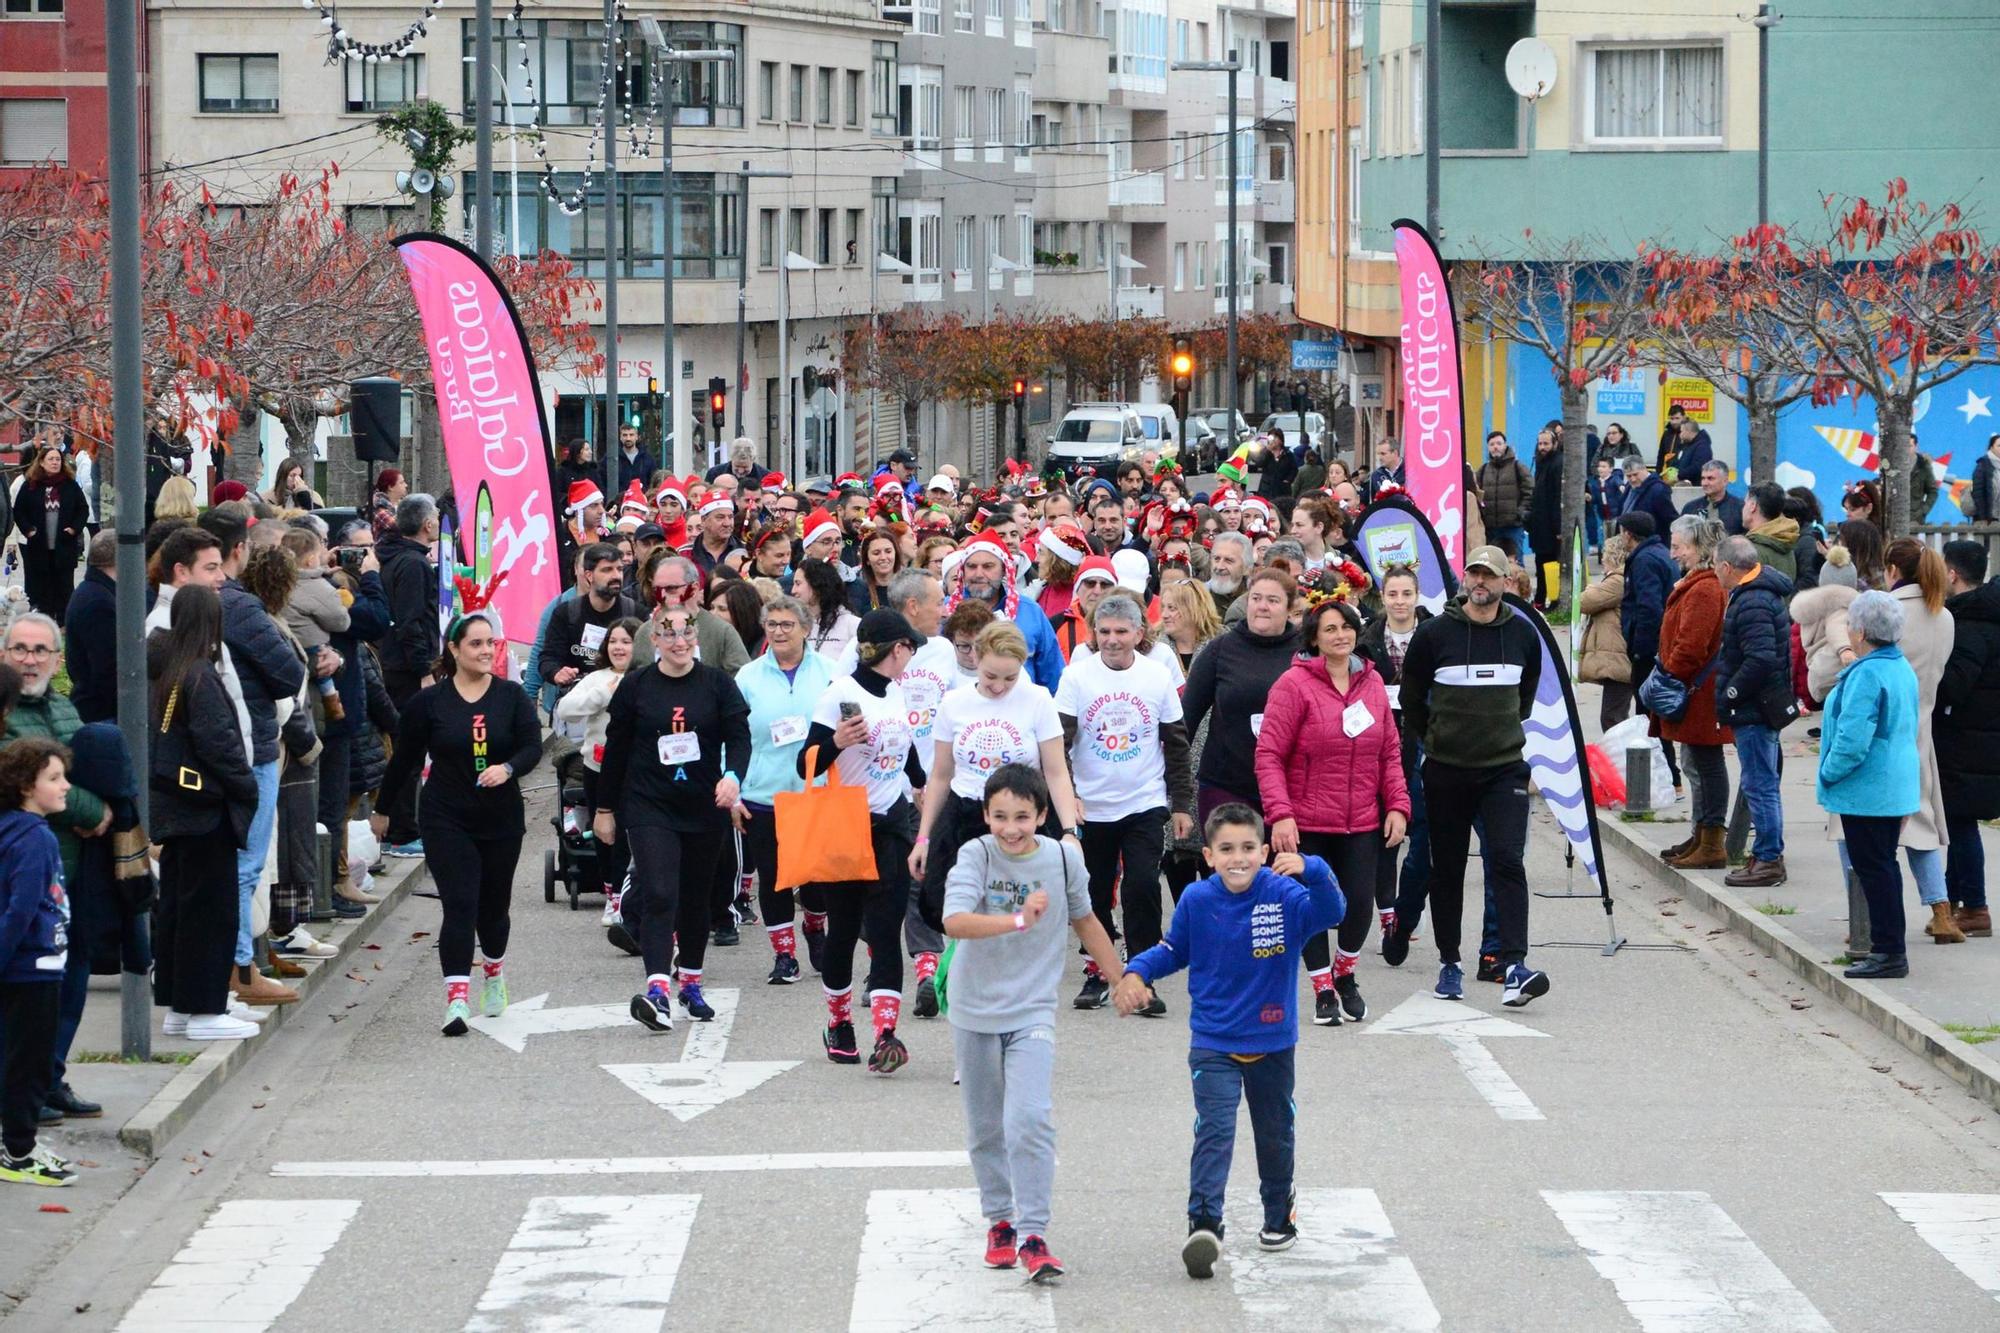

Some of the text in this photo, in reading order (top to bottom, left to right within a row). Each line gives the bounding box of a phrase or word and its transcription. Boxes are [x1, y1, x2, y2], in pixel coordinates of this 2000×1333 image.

[1670, 381, 1709, 392] FREIRE
[911, 669, 926, 677] LAS
[1086, 691, 1153, 725] EQUIPO LAS CHICAS
[959, 718, 1024, 746] EQUIPO LAS CHICAS
[472, 714, 488, 785] ZUMB
[1096, 747, 1112, 761] LOS
[1112, 744, 1142, 763] CHICOS
[988, 880, 1021, 893] JACK
[1252, 903, 1283, 915] SONIC
[1251, 914, 1284, 926] SONIC
[1252, 924, 1284, 937] SONIC
[1252, 935, 1285, 948] SONIC
